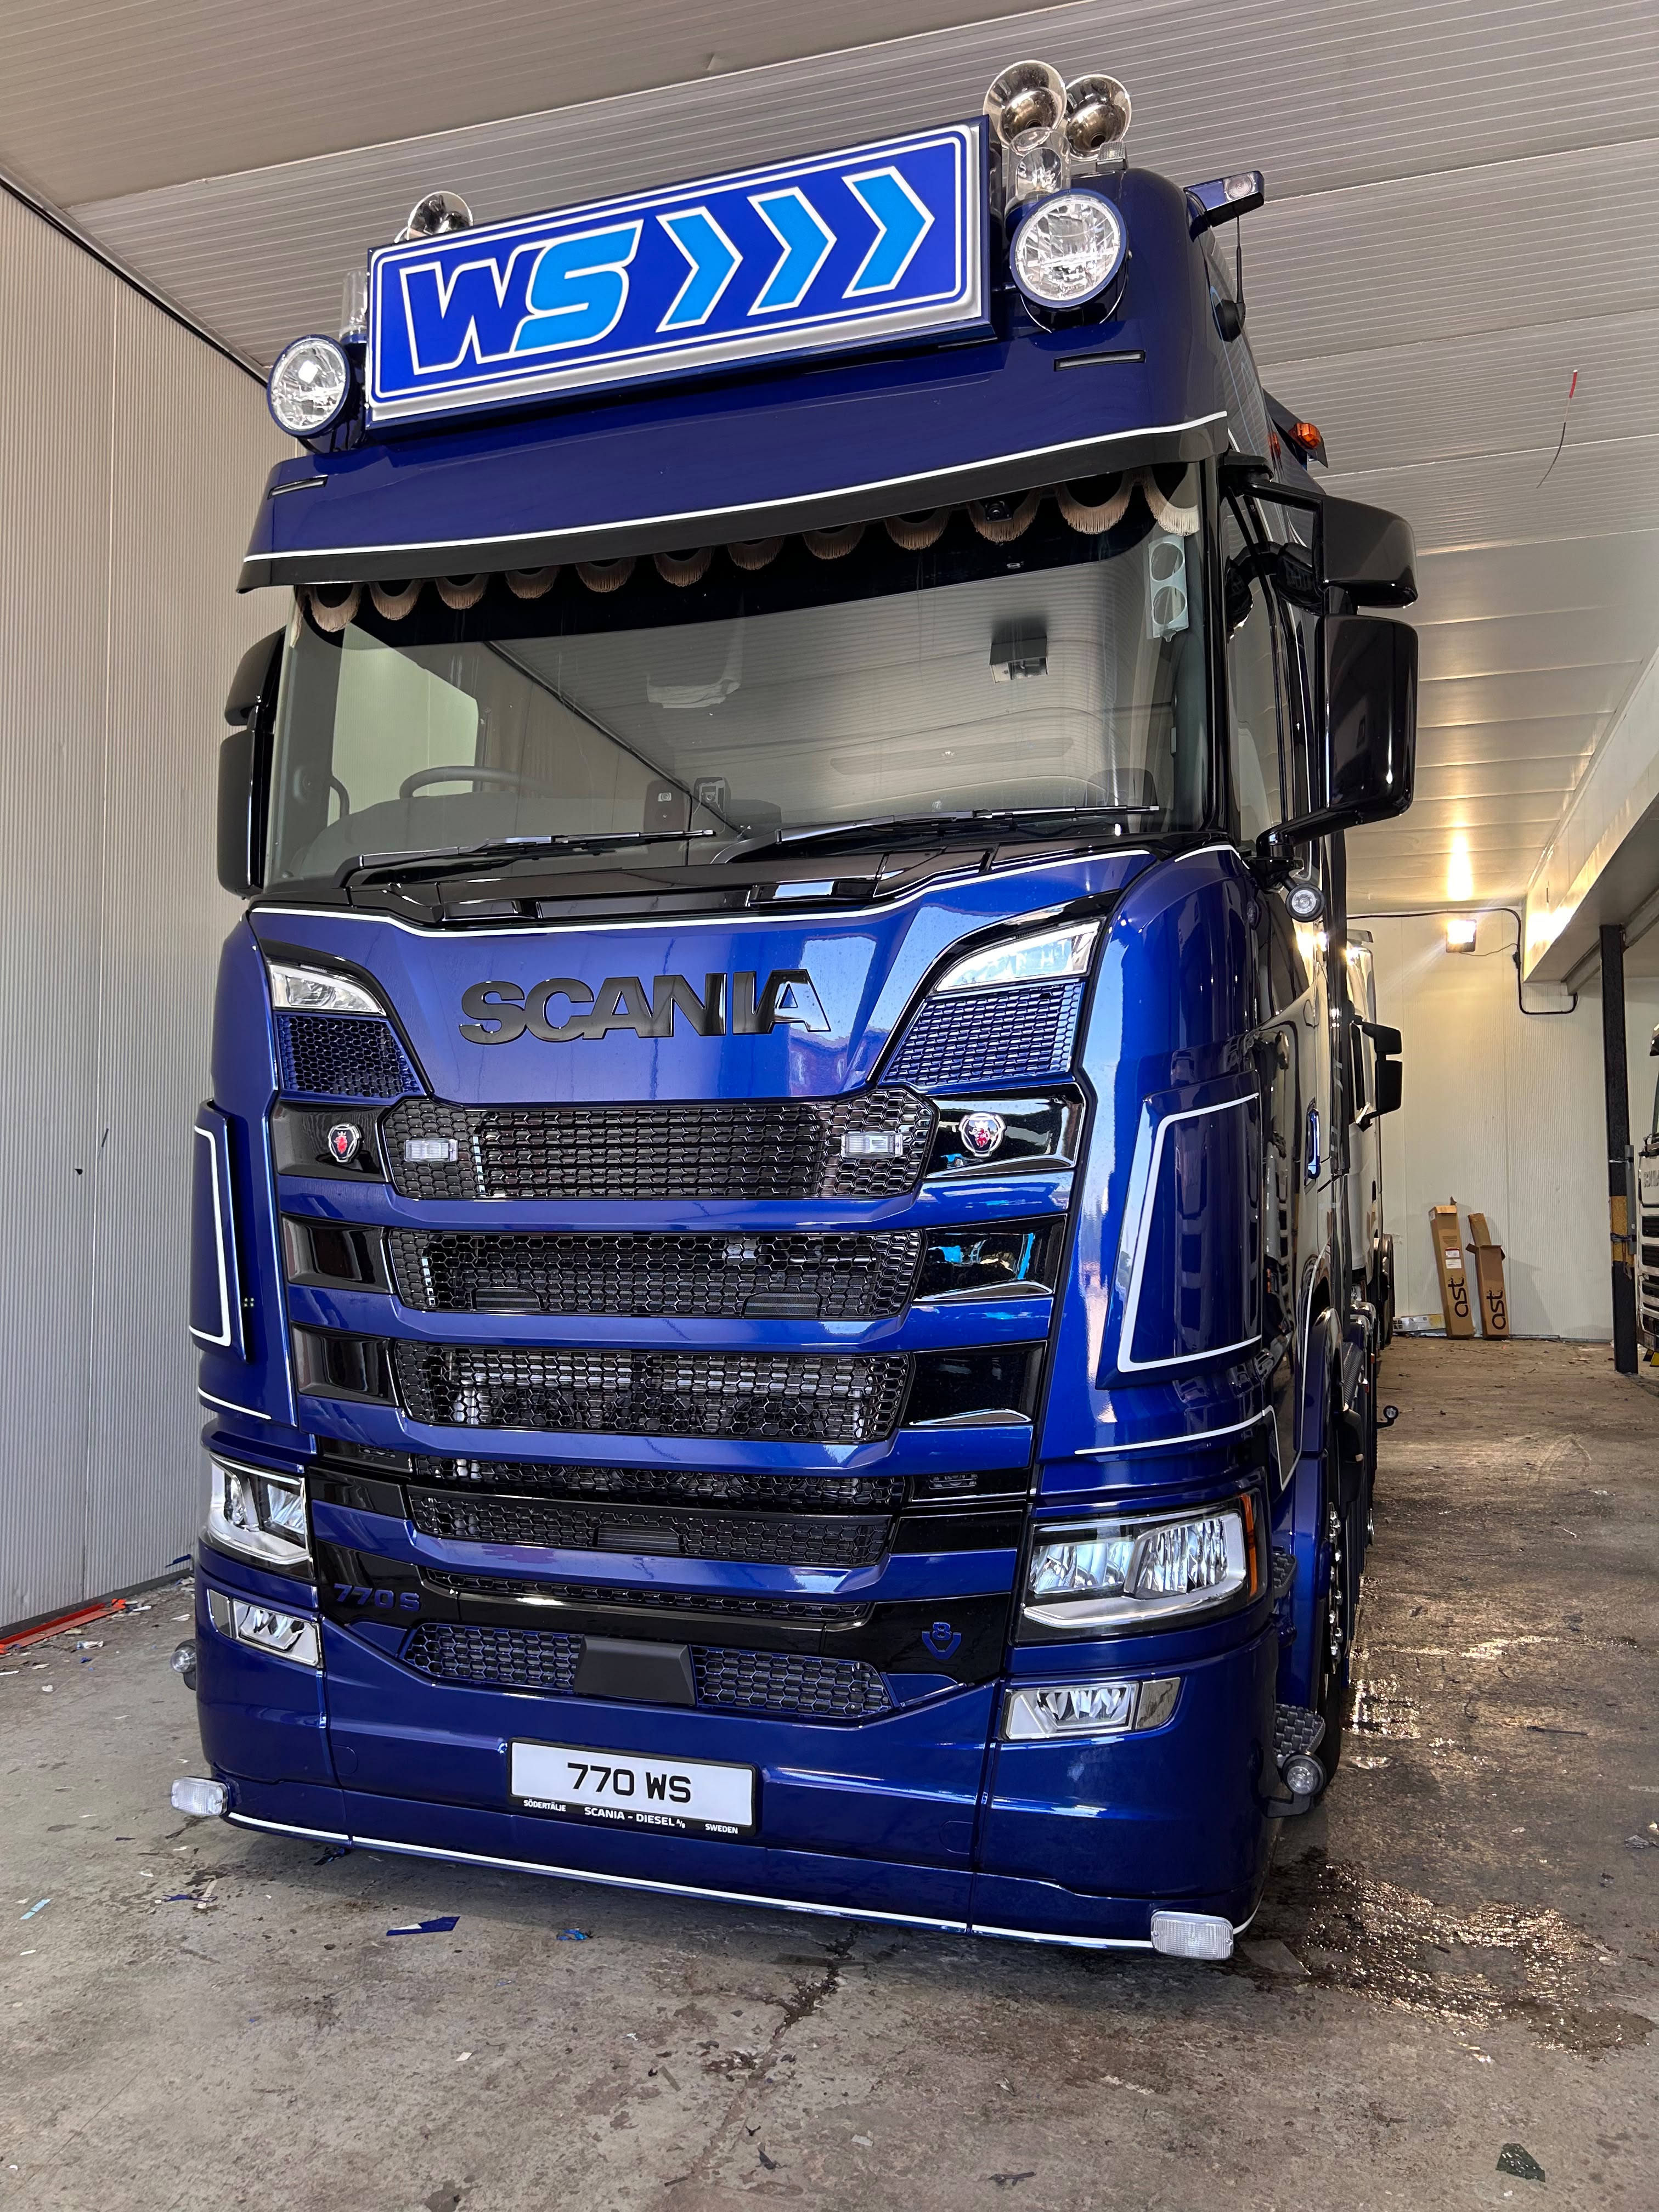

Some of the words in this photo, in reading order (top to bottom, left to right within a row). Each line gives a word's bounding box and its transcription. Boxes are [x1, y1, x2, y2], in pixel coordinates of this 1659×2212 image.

[399, 219, 642, 375] WS
[459, 968, 831, 1045] SCANIA
[334, 1583, 395, 1609] 770
[399, 1592, 420, 1611] S
[567, 1762, 634, 1796] 770
[646, 1771, 691, 1803] WS
[523, 1798, 566, 1812] SÖDERTÄLJE
[584, 1807, 625, 1820] SCANIA
[636, 1813, 675, 1826] DIESEL
[705, 1823, 738, 1834] SWEDEN
